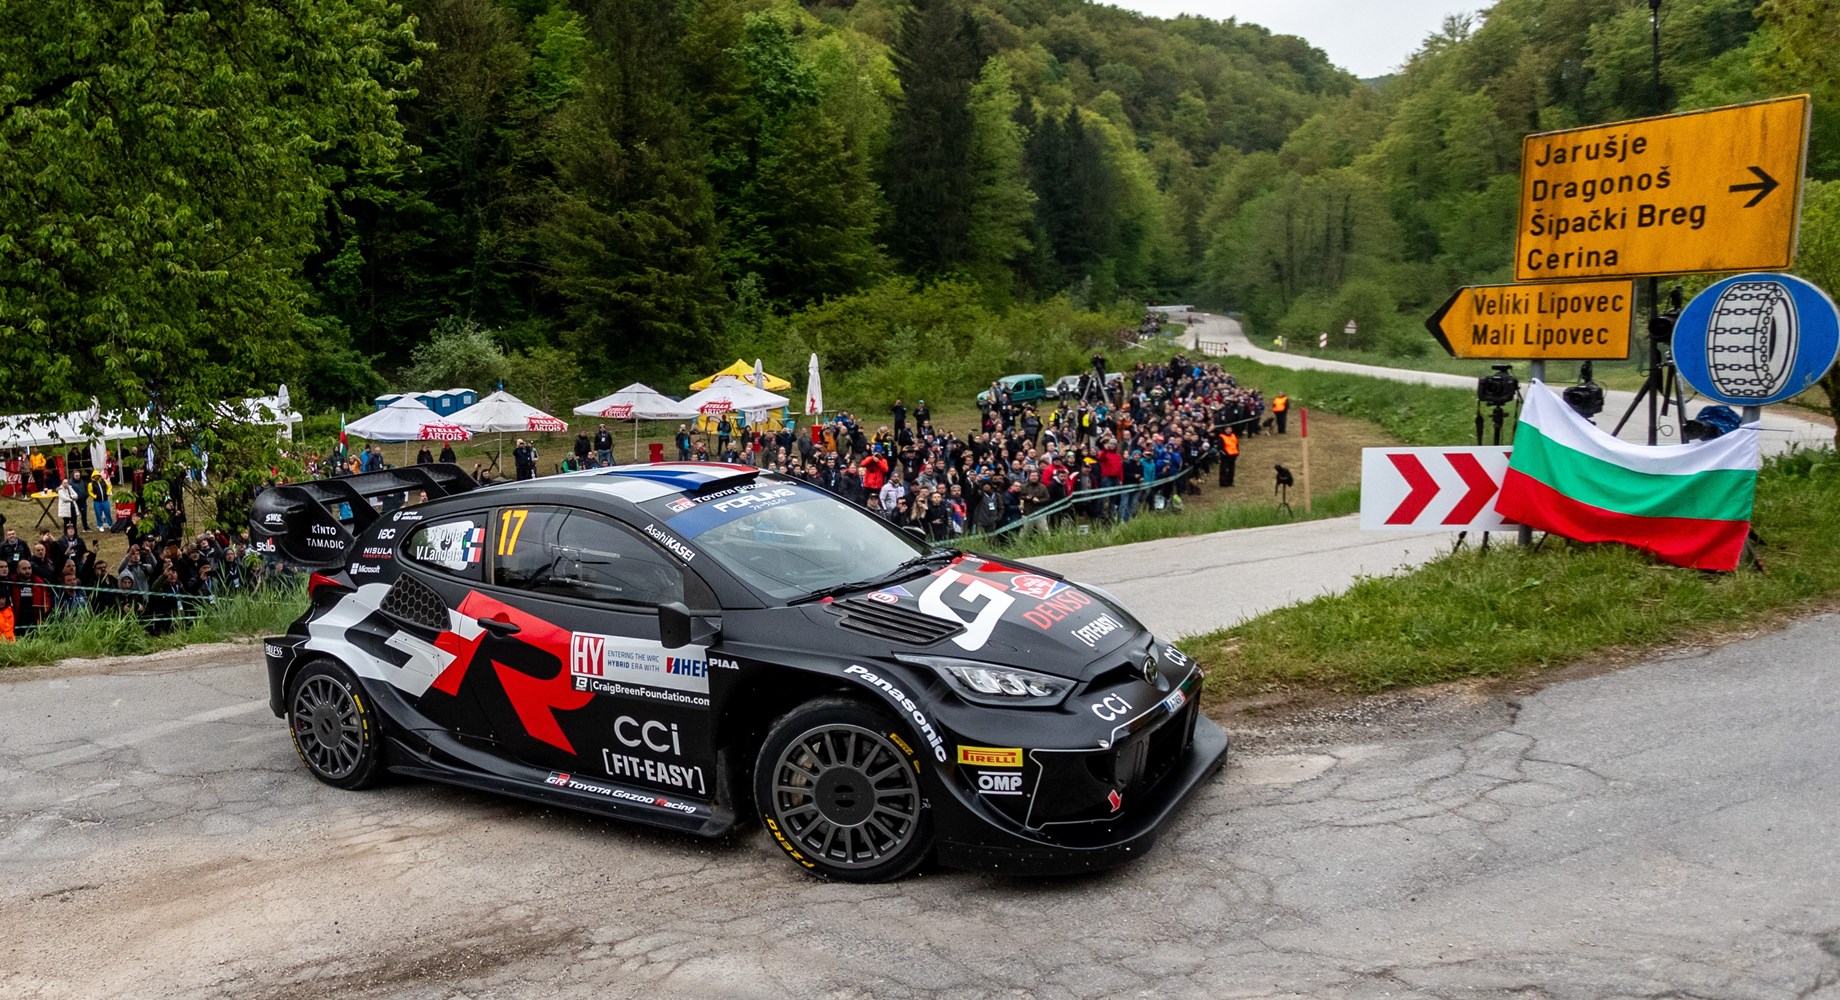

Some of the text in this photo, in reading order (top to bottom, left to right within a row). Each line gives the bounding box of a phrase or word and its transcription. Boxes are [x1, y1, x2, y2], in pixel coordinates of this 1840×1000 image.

[1535, 134, 1647, 167] Jarušje
[1532, 165, 1671, 202] Dragonoš
[1530, 204, 1706, 240] Šipački Breg
[1527, 248, 1618, 271] Cerina
[1474, 291, 1623, 319] Veliki Lipovec
[1472, 323, 1609, 350] Mali Lipovec
[427, 432, 463, 441] ARTOIS
[693, 488, 735, 503] TOYOTA
[712, 488, 796, 513] FORUM8
[256, 537, 276, 552] Stilo
[306, 538, 345, 550] TAMADIC
[497, 509, 529, 556] 17
[644, 523, 696, 562] AsahiKASEI
[363, 547, 393, 555] NISULA
[358, 564, 380, 574] Microsoft
[1022, 590, 1092, 630] DENSO
[574, 635, 604, 675] HY
[607, 650, 660, 662] ENTERING THE WRC
[607, 660, 660, 673] HYBRID ERA WITH
[709, 657, 740, 671] PIAA
[843, 664, 947, 763] Panasonic
[963, 749, 1016, 764] PIRELLI
[978, 775, 1023, 791] OMP
[568, 780, 611, 796] TOYOTA
[612, 789, 655, 804] GAZOO
[655, 797, 697, 814] Racing
